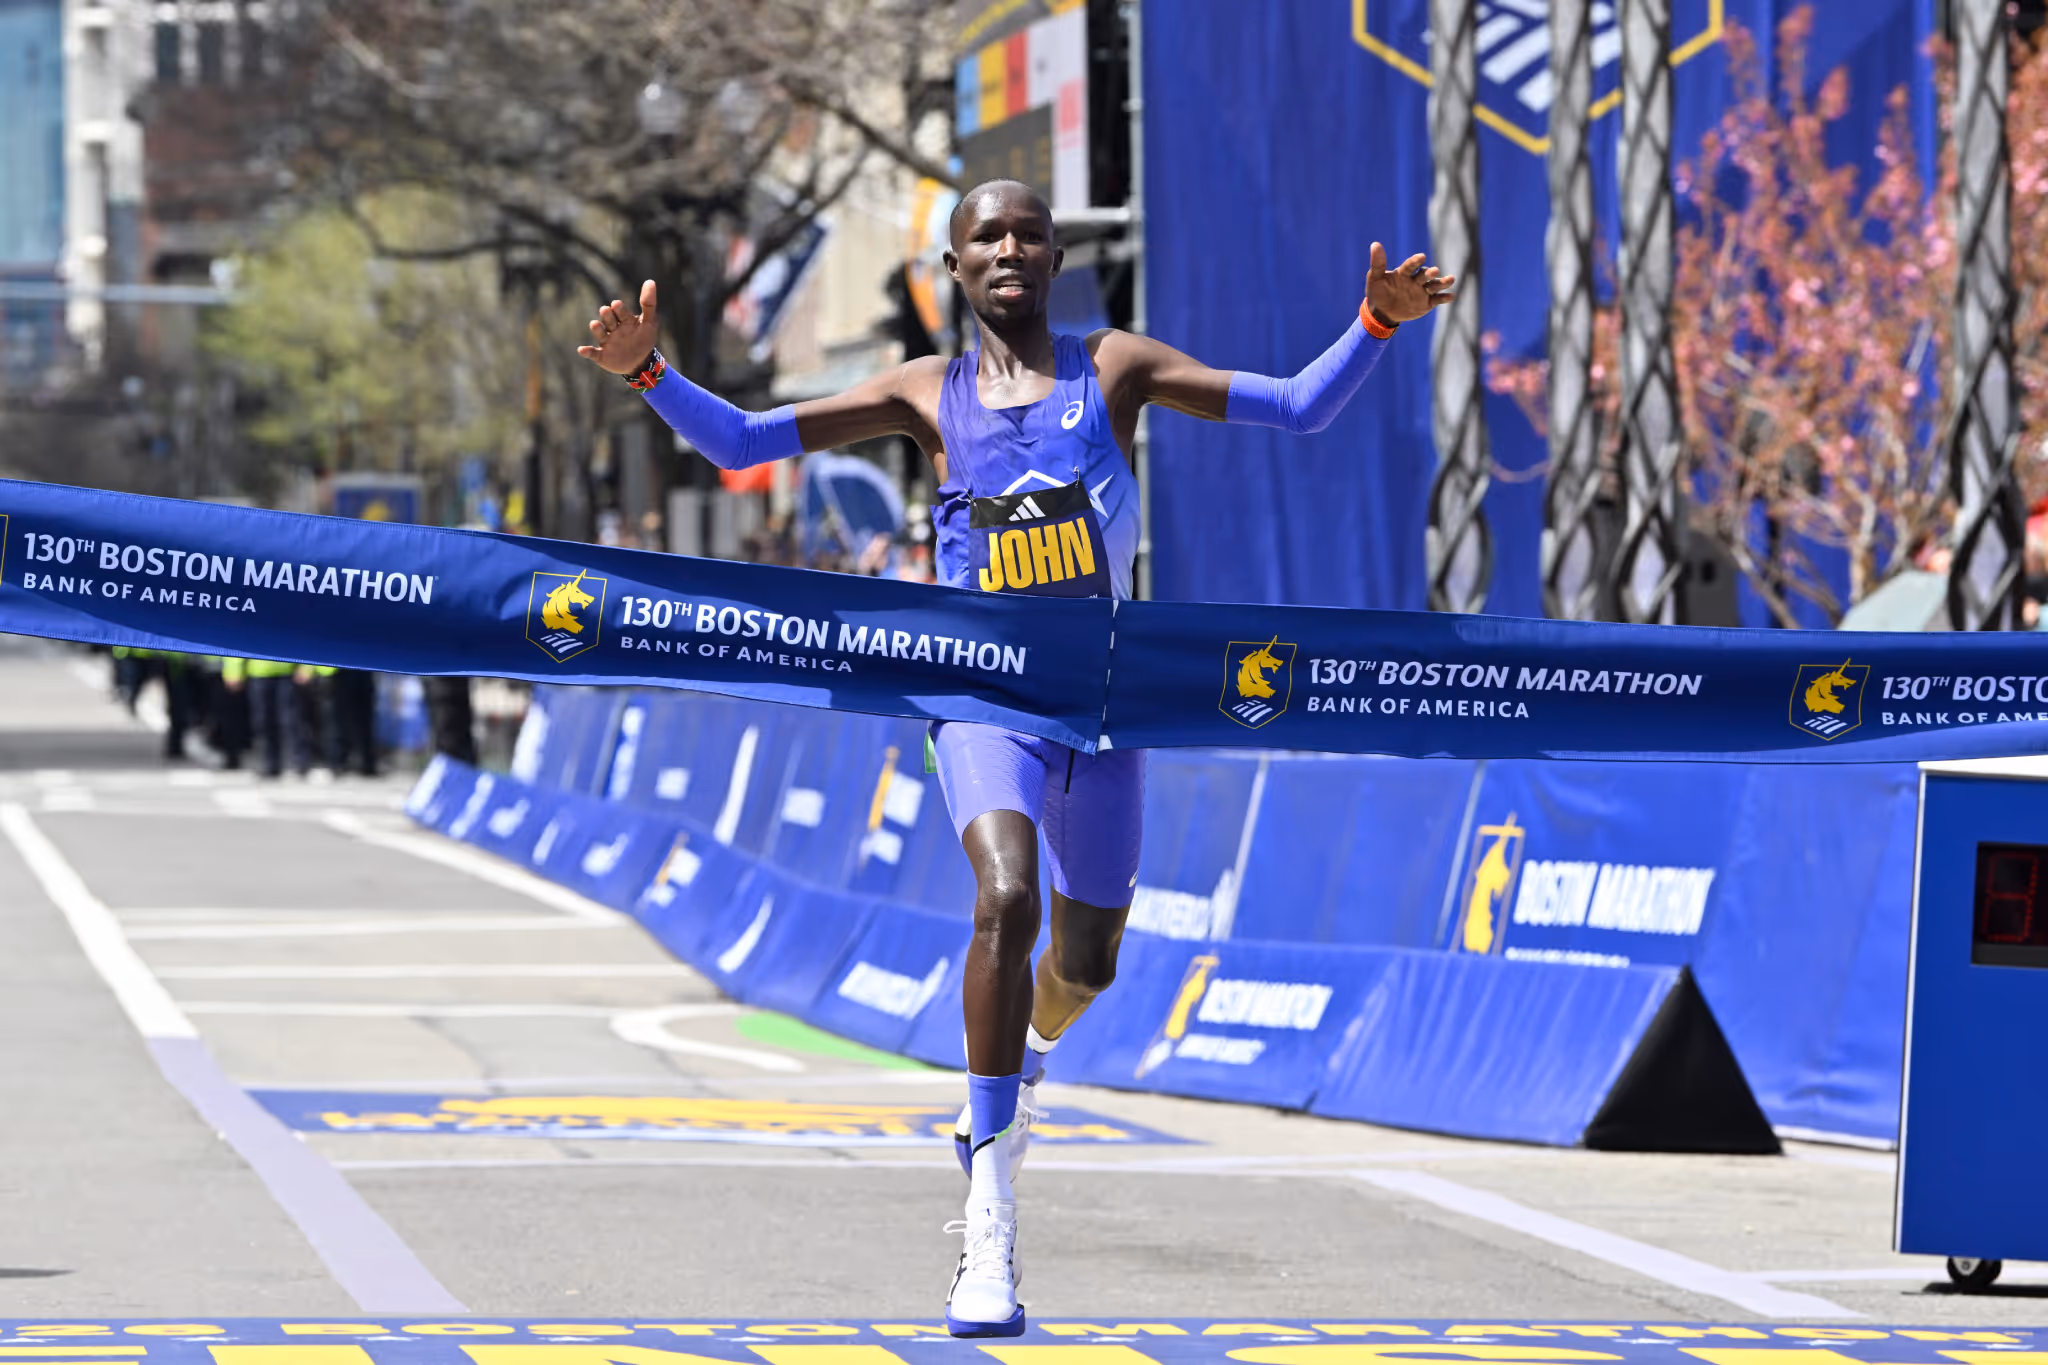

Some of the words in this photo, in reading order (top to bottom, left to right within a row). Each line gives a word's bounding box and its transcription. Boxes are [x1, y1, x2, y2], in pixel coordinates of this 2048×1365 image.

[24, 532, 95, 564] 130TH
[99, 542, 234, 584] BOSTON
[243, 558, 434, 605] MARATHON
[979, 517, 1096, 592] JOHN
[23, 572, 93, 595] BANK
[101, 581, 134, 599] OF
[139, 586, 257, 613] AMERICA
[621, 595, 693, 629] 130TH
[695, 603, 830, 650] BOSTON
[837, 623, 1027, 675] MARATHON
[620, 636, 689, 654] BANK
[698, 643, 730, 658] OF
[736, 646, 853, 673] AMERICA
[1308, 658, 1377, 685] 130TH
[1377, 661, 1511, 688] BOSTON
[1514, 667, 1703, 695] MARATHON
[1882, 676, 1950, 700] 130TH
[1307, 696, 1372, 713] BANK
[1380, 697, 1411, 714] OF
[1415, 699, 1529, 718] AMERICA
[1882, 712, 1950, 725] BANK
[1957, 712, 1988, 724] OF
[0, 1324, 227, 1336] 26
